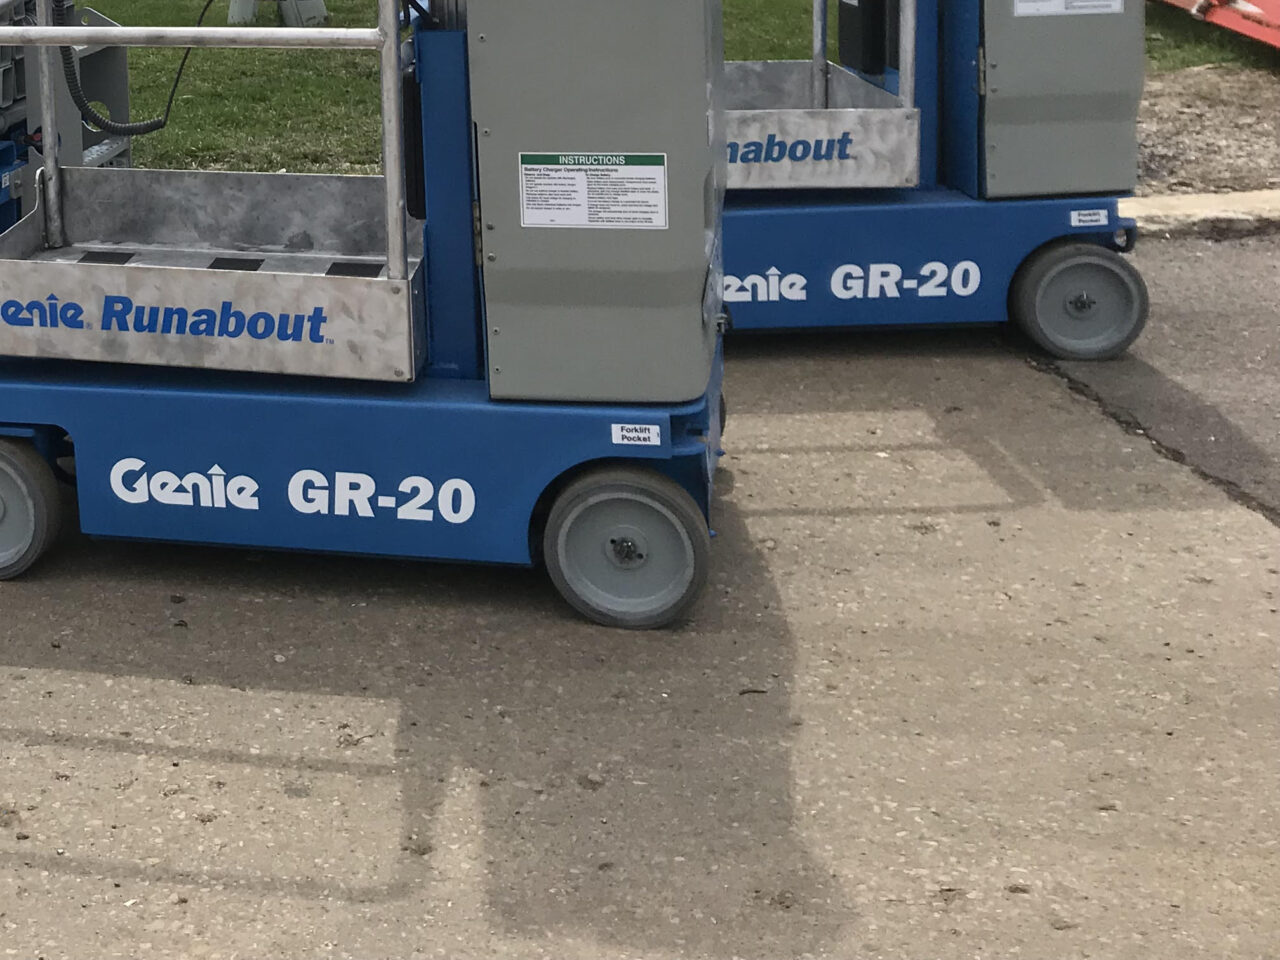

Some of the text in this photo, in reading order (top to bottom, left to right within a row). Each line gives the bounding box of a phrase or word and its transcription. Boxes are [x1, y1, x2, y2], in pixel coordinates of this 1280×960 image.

[559, 155, 626, 165] INSTRUCTIONS
[727, 132, 853, 164] nabout
[723, 260, 981, 302] enie GR-20
[100, 294, 327, 344] Runabout
[621, 426, 650, 434] Forklift
[622, 434, 651, 442] Pocket
[110, 457, 476, 524] Genie GR-20
